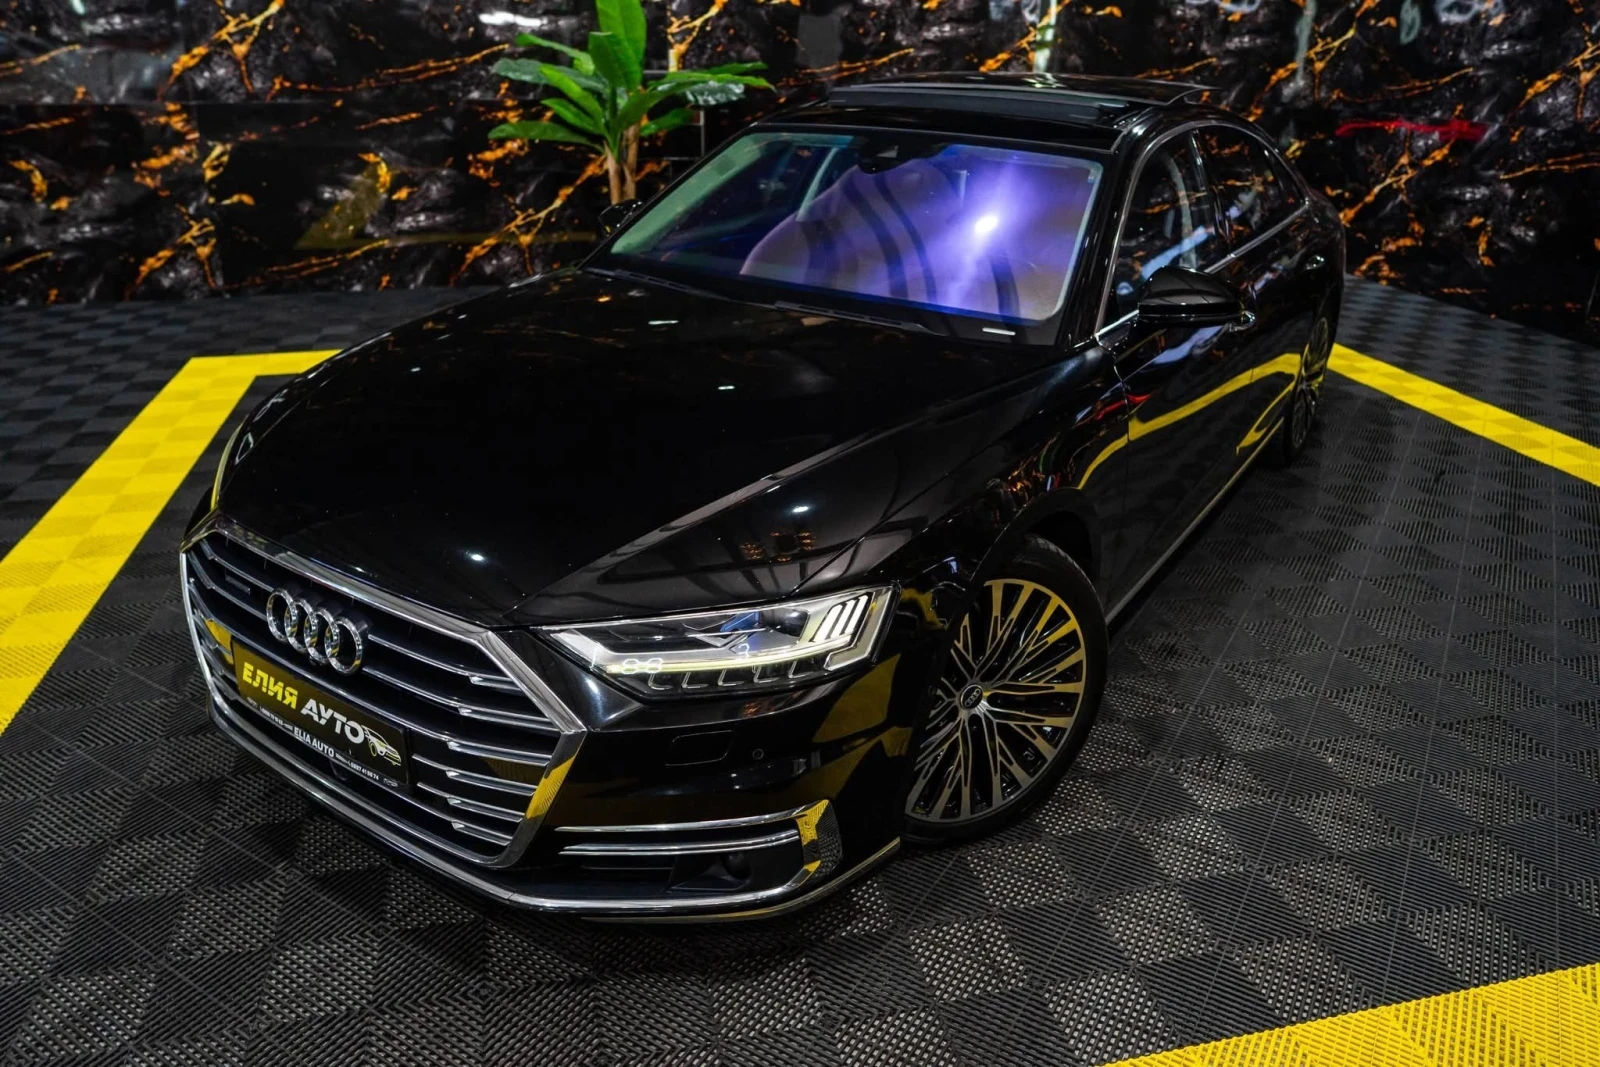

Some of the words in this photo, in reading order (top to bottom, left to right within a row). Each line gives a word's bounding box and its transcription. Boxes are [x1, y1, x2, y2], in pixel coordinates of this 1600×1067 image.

[242, 662, 298, 709] ЕЛИЯ
[301, 698, 365, 744] АУТО
[293, 726, 312, 745] ELIA
[311, 738, 335, 758] AUTO
